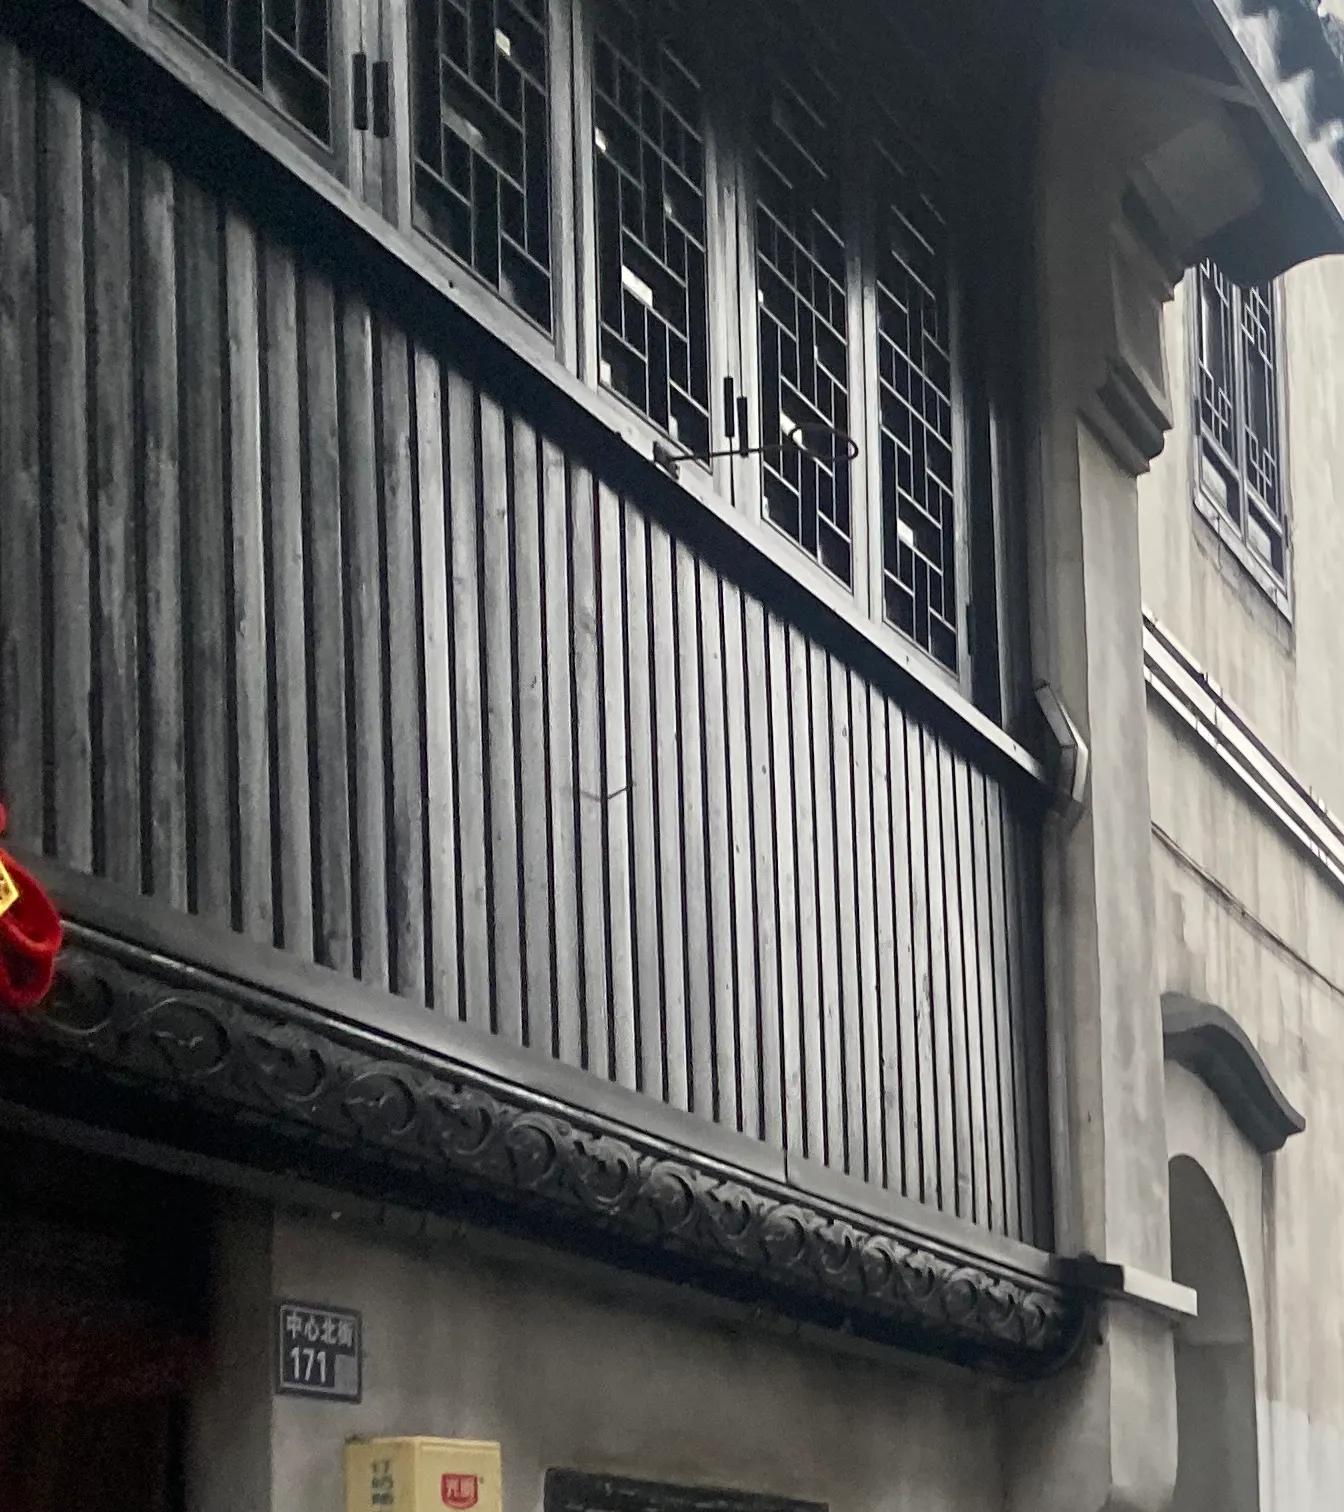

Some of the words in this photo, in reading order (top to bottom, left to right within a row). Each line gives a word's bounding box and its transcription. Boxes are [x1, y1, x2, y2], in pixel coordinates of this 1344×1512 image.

[286, 1312, 353, 1347] 中心北街
[291, 1346, 326, 1383] 171
